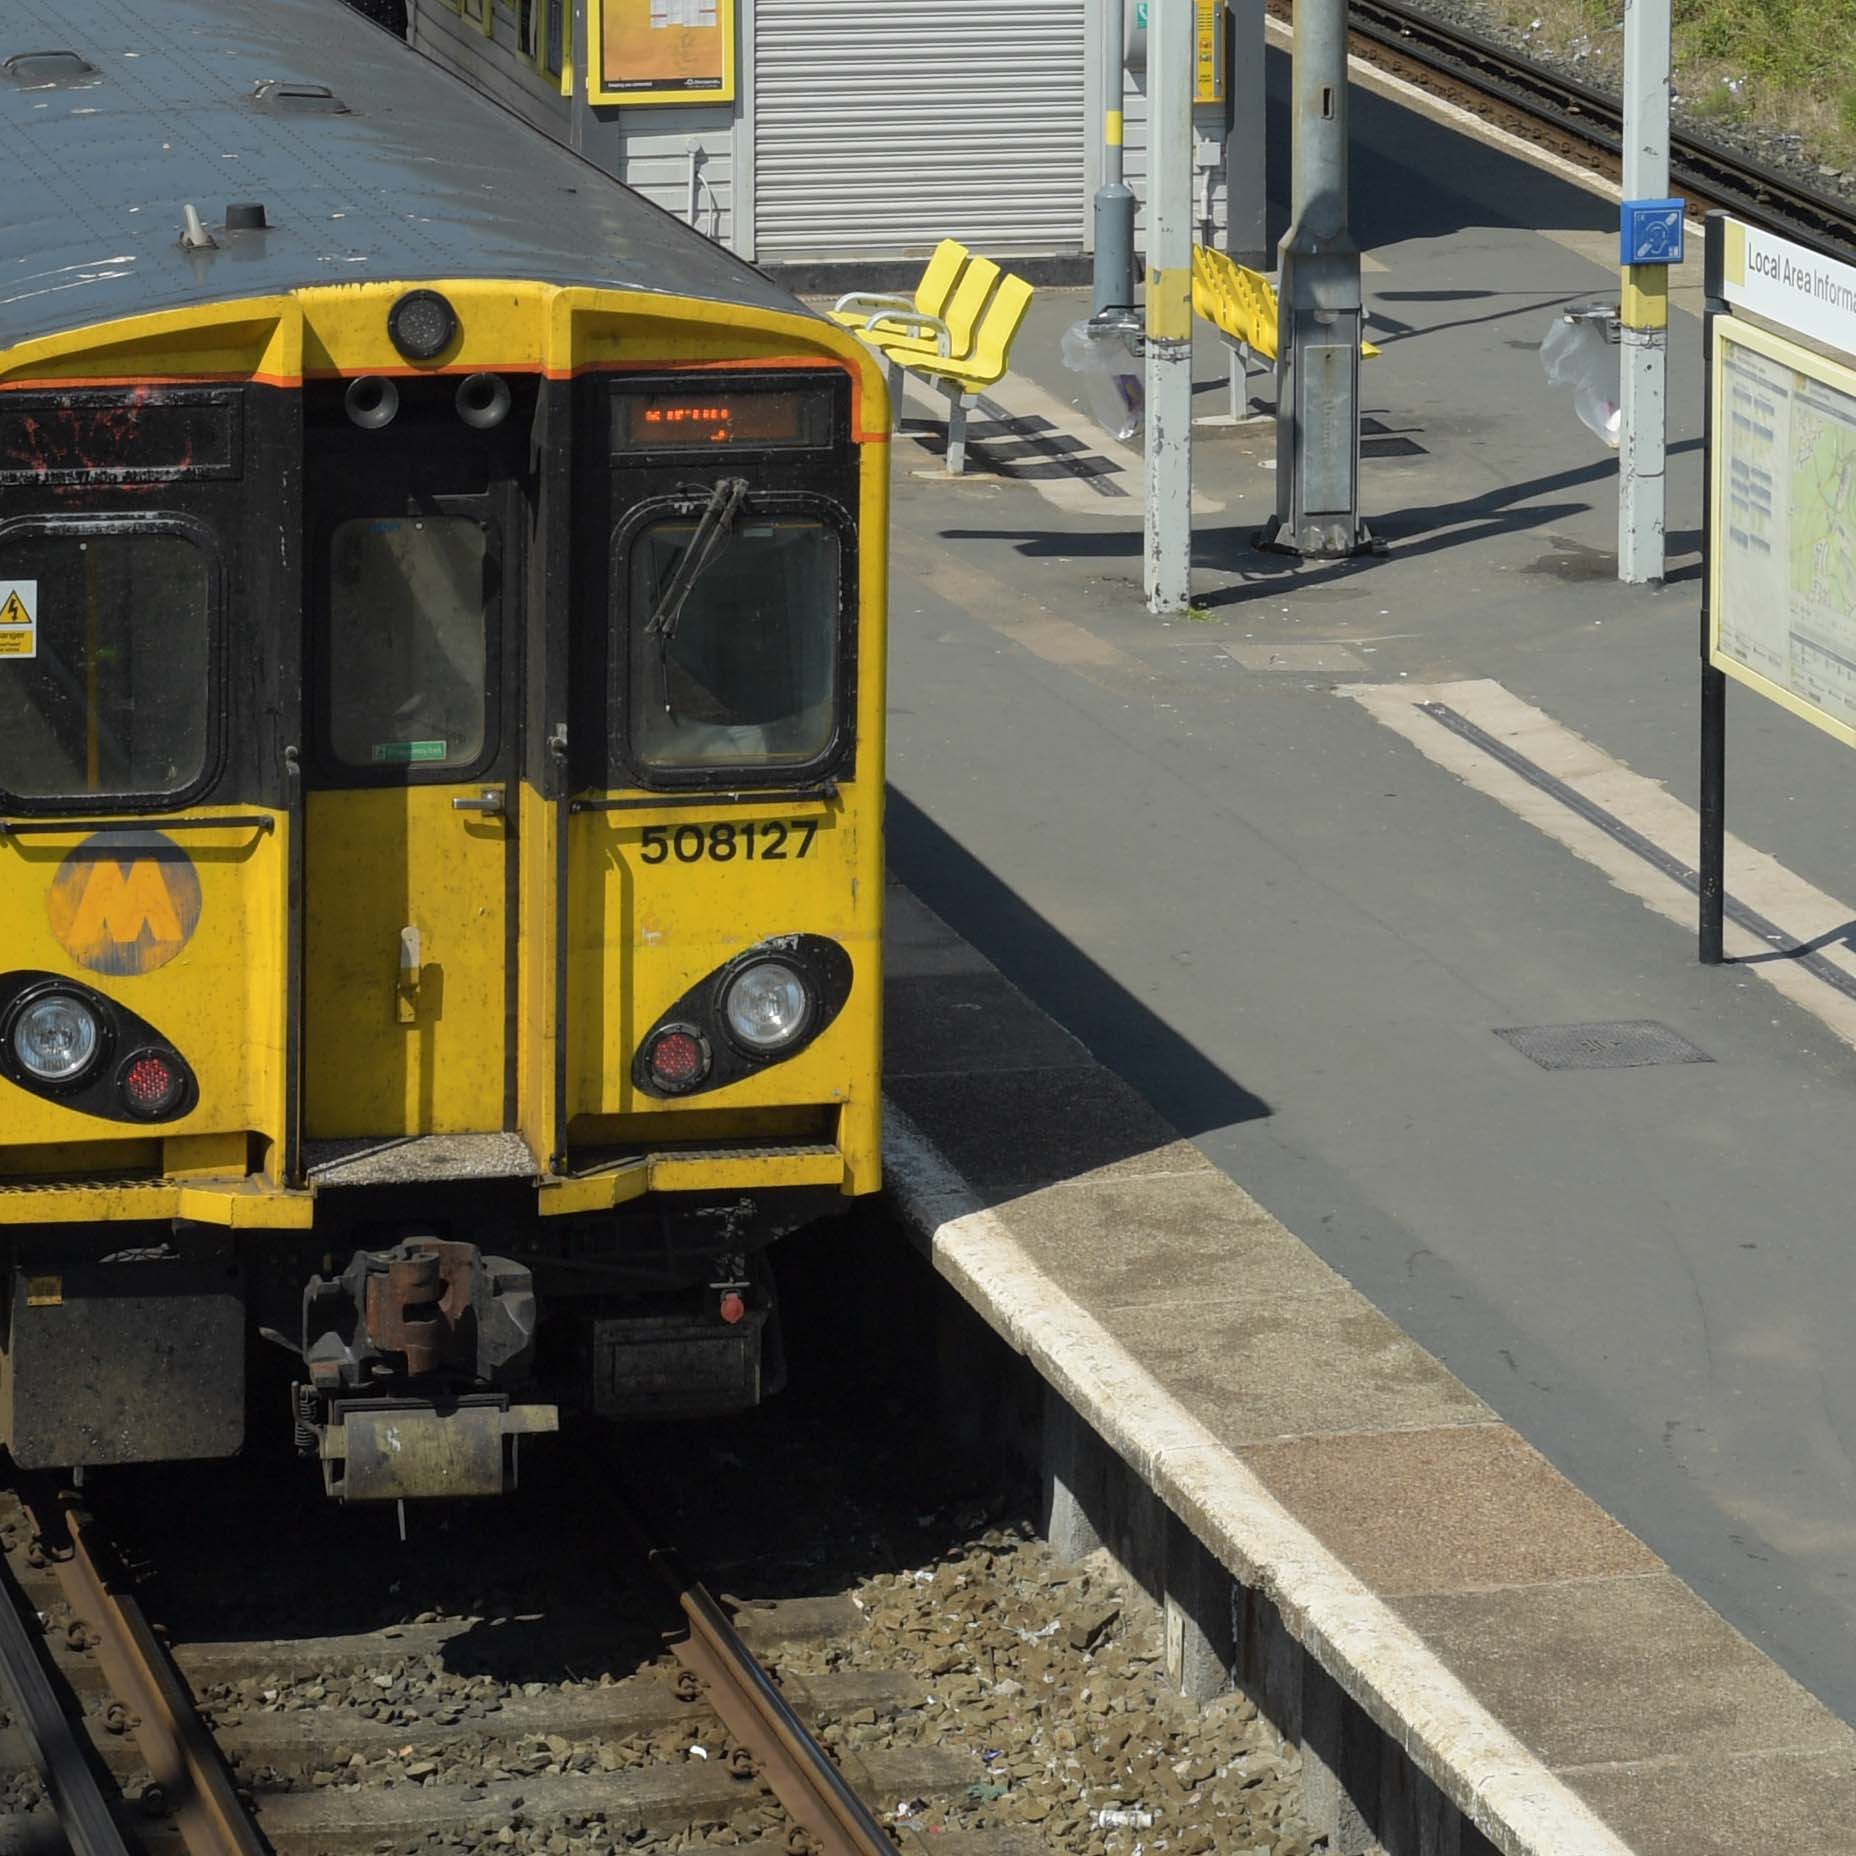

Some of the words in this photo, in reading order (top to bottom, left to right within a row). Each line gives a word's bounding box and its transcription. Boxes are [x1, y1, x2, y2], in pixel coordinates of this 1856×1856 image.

[1748, 241, 1781, 281] Local
[1783, 257, 1811, 294] Area
[640, 820, 819, 865] 508127
